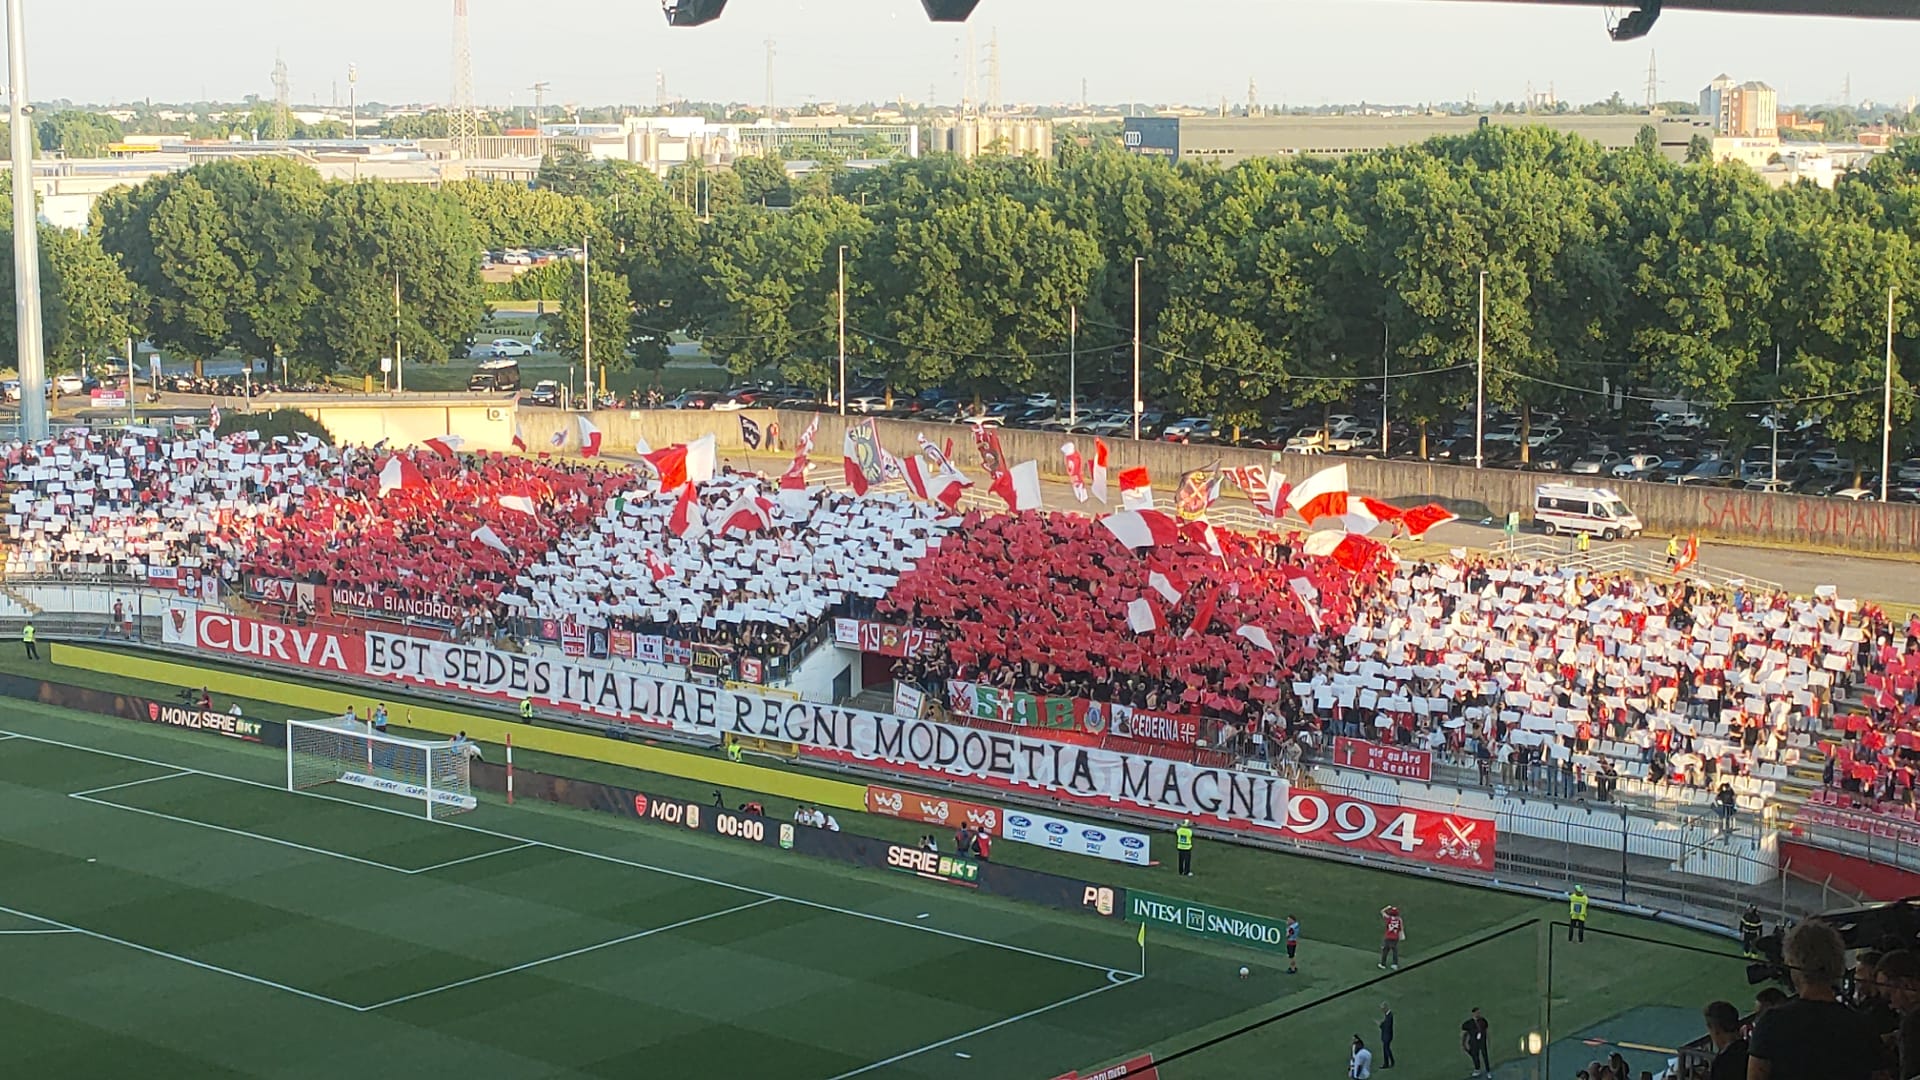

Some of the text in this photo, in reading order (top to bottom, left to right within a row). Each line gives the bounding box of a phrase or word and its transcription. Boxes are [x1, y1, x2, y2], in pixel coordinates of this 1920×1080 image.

[1703, 494, 1774, 532] SARA
[333, 588, 374, 608] MONZA
[199, 615, 347, 670] CURVA
[861, 622, 880, 651] 19
[202, 711, 237, 732] SERIE
[370, 635, 1275, 822] EST SEDES ITALIAE REGNI MODOETIA MAGNI
[1132, 713, 1179, 742] CEDERNA
[716, 813, 764, 842] 00:00
[887, 846, 978, 879] SERIE BKT
[1133, 898, 1281, 945] INTESA SANPAOLO
